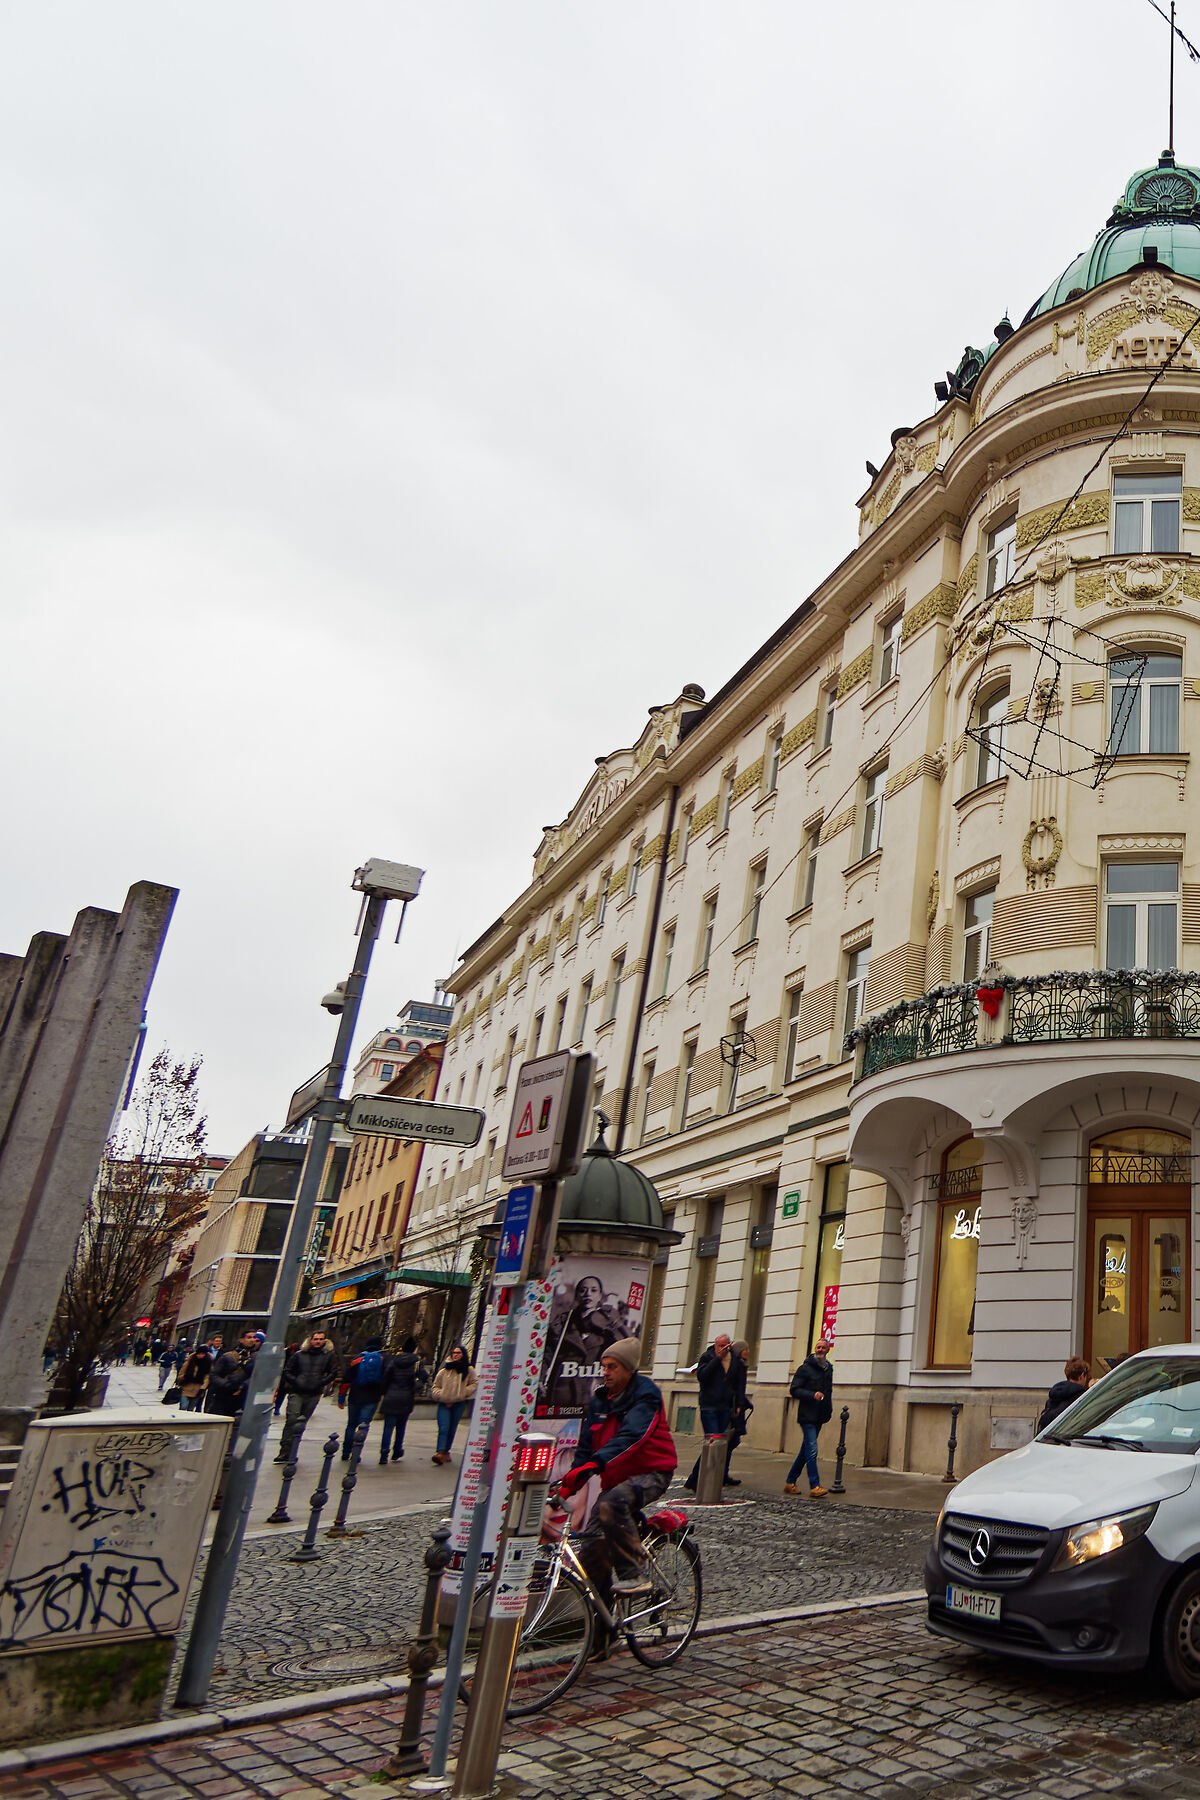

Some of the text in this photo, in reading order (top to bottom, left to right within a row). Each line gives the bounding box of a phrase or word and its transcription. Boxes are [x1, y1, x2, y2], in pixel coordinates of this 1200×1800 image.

[1111, 336, 1192, 359] HOTEL
[425, 1122, 455, 1136] cesta
[1090, 1156, 1181, 1172] KAVARNA
[953, 1590, 964, 1608] LJ
